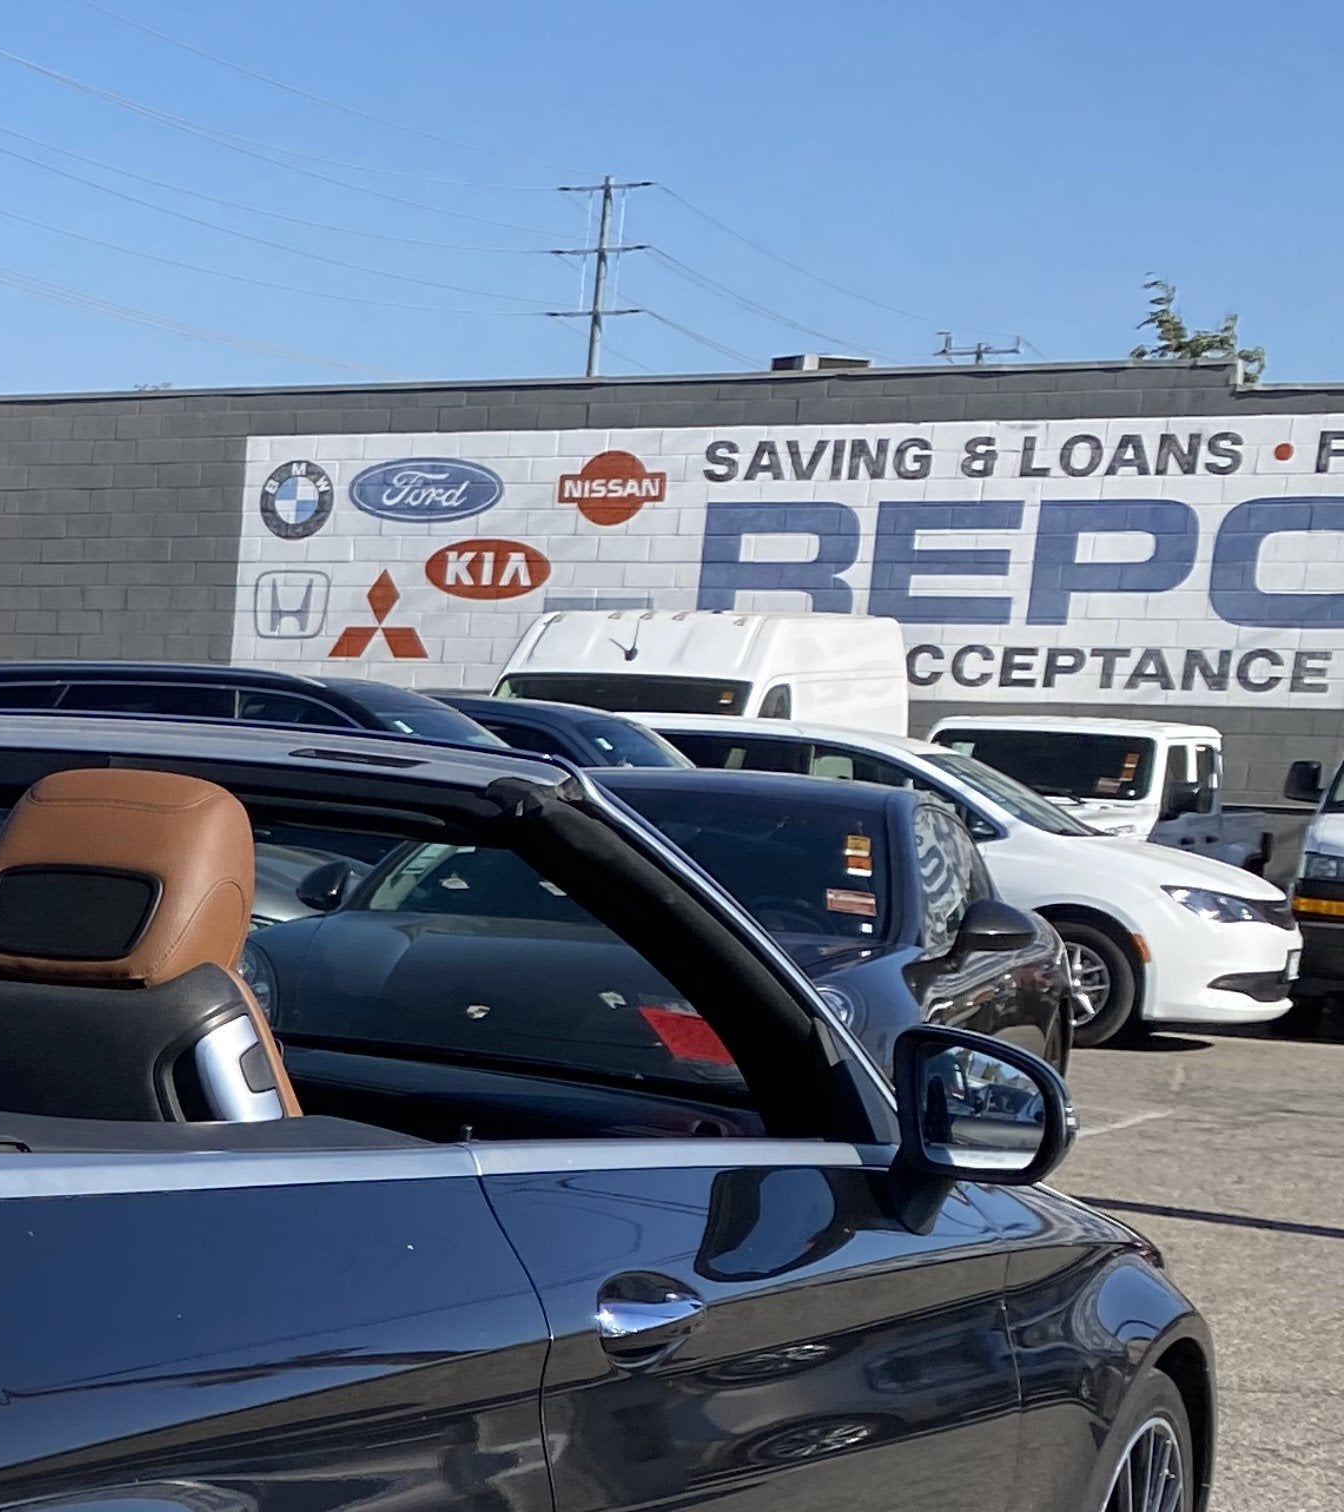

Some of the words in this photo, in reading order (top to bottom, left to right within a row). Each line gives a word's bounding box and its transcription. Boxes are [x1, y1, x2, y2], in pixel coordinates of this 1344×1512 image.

[703, 437, 933, 483] SAVING
[960, 436, 999, 478] &
[1019, 431, 1243, 476] LOANS
[264, 462, 331, 494] BMW
[382, 470, 470, 507] Ford
[563, 477, 661, 499] NISSAN
[444, 551, 532, 587] KIA
[906, 643, 1332, 694] CCEPTANCE
